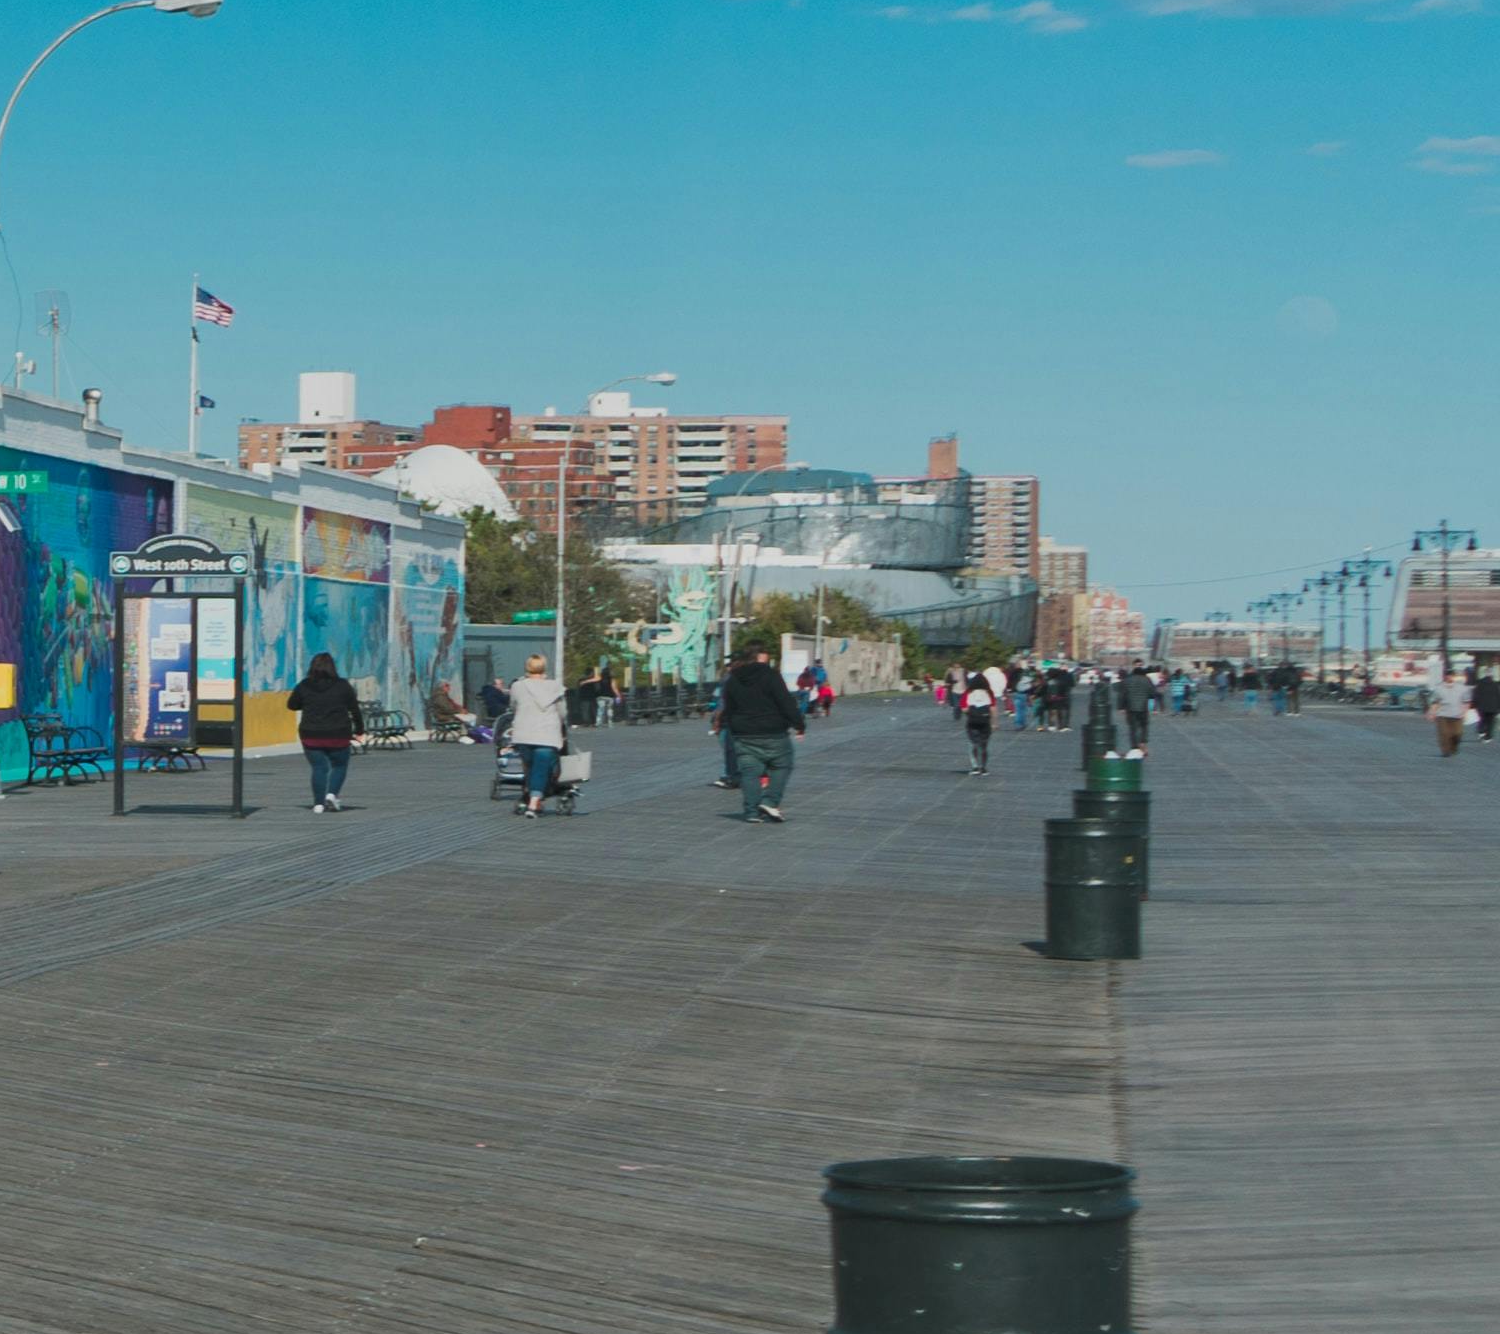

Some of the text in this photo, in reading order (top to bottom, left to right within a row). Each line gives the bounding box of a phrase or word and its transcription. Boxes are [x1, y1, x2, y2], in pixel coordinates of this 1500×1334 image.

[14, 473, 27, 490] 10
[133, 558, 227, 571] West 10th Street
